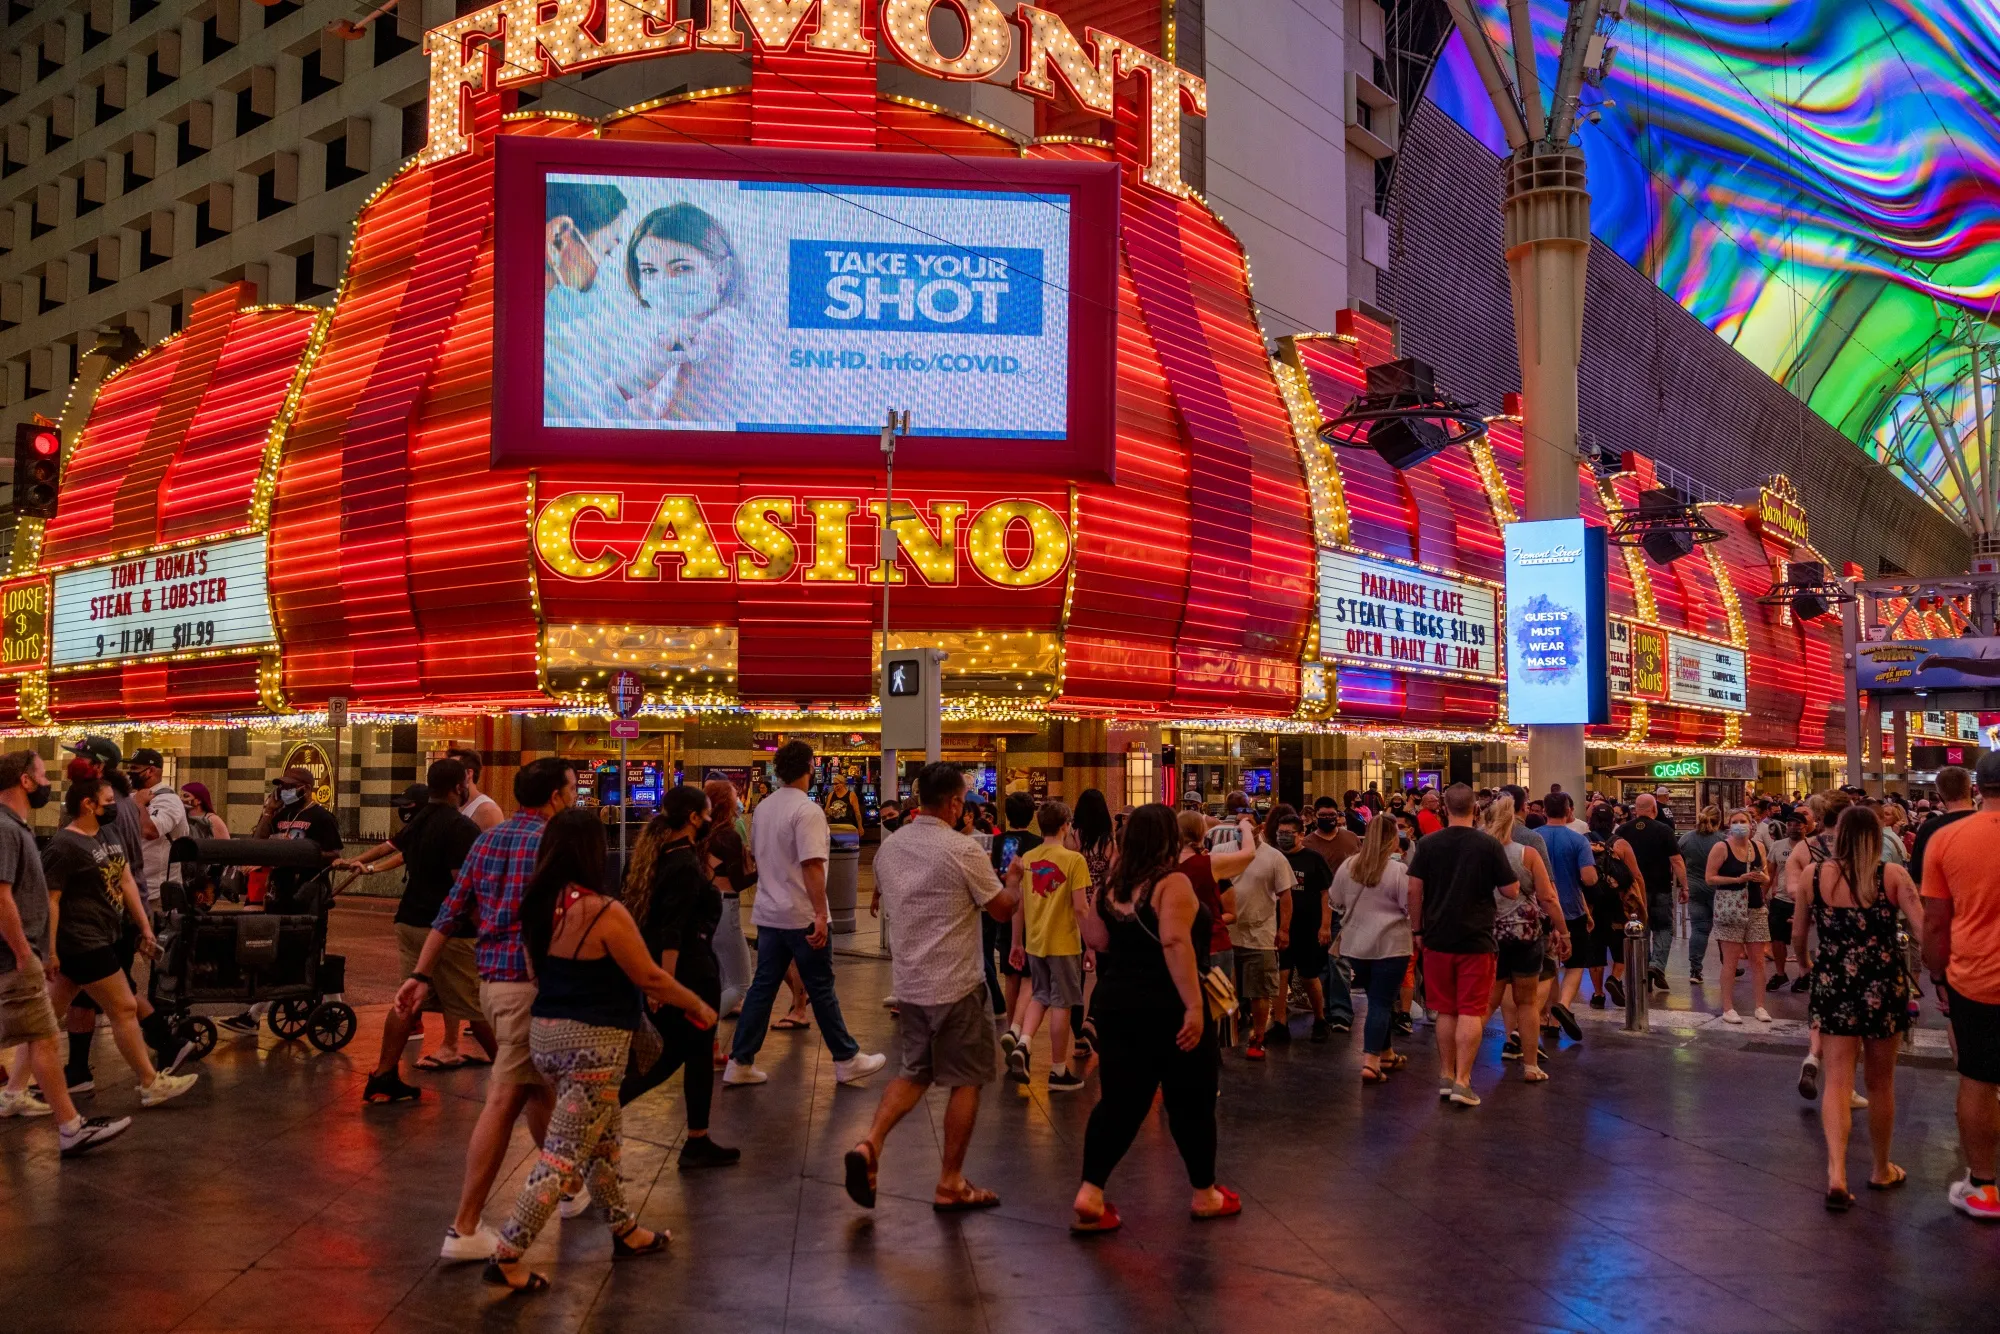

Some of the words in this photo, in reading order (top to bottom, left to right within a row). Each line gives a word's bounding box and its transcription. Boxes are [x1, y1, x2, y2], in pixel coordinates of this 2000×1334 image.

[420, 0, 1207, 199] FREMONT
[824, 250, 907, 275] TAKE
[913, 253, 1009, 279] YOUR
[824, 275, 1010, 324] SHOT
[1762, 491, 1781, 527] Sam
[535, 490, 1069, 590] CASINO
[1512, 547, 1550, 562] Fremont
[1552, 544, 1582, 557] Street
[111, 560, 147, 590] TONY
[155, 550, 208, 582] ROMA'S
[3, 587, 42, 619] LOOSE
[90, 591, 133, 621] STEAK
[142, 588, 152, 613] &
[161, 577, 227, 611] LOBSTER
[1361, 571, 1426, 609] PARADISE
[1434, 588, 1464, 616] CAFE
[16, 612, 27, 636] $
[1336, 596, 1387, 629] STEAK
[1395, 607, 1404, 632] &
[1414, 610, 1444, 640] EGGS
[1451, 617, 1485, 646] $11.99
[1525, 611, 1568, 622] GUESTS
[96, 634, 105, 657] 9
[172, 620, 214, 652] $11.99
[1531, 626, 1561, 637] MUST
[3, 633, 39, 663] SLOTS
[1346, 628, 1383, 657] OPEN
[1391, 635, 1426, 663] DAILY
[1434, 643, 1448, 666] AT
[1455, 645, 1479, 670] 7AM
[1529, 642, 1564, 651] WEAR
[1610, 651, 1624, 663] TEAK
[1637, 633, 1662, 660] LOOSE
[1527, 656, 1567, 666] MASKS
[1646, 654, 1654, 672] $
[617, 677, 634, 686] FREE
[1639, 668, 1662, 692] SLOTS
[1875, 671, 1894, 682] SUPER
[1895, 669, 1912, 678] HERO
[611, 685, 640, 695] SHUTTLE
[603, 739, 620, 749] BITE
[1654, 761, 1700, 777] CIGARS
